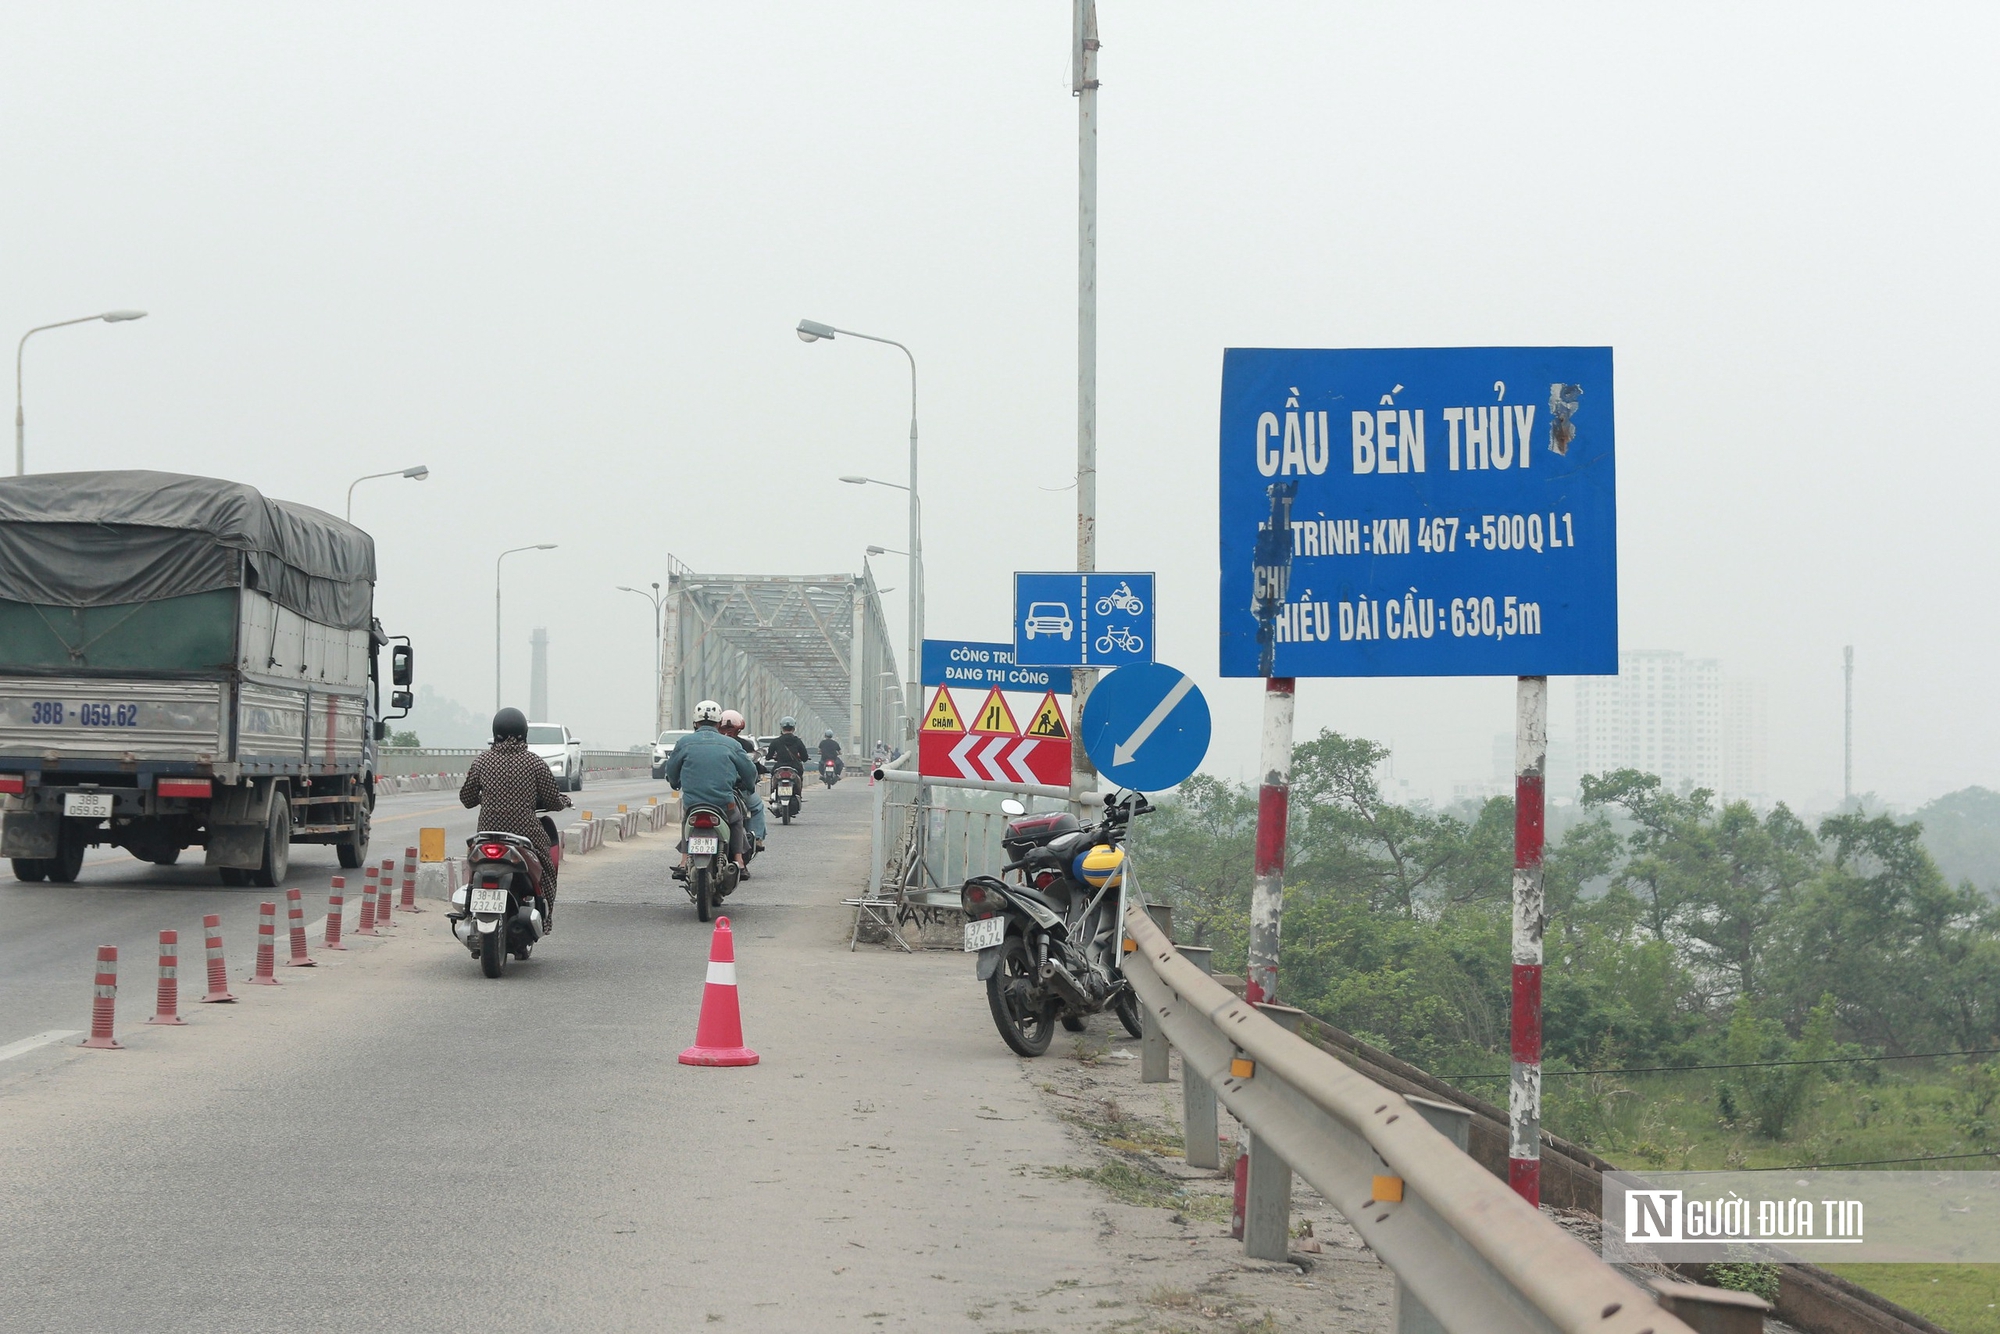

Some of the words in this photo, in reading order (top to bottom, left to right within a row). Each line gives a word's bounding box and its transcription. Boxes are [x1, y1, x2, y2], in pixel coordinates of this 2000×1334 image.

[1256, 386, 1329, 477] CẦU
[1351, 383, 1426, 475] BẾN
[1443, 380, 1536, 471] THỦY
[1417, 517, 1459, 553] 467
[1275, 588, 1331, 643] HIỀU
[1338, 593, 1380, 641] DÀI
[950, 646, 990, 663] CÔNG
[993, 651, 1014, 664] TRU
[945, 666, 983, 681] ĐANG
[986, 669, 1005, 682] THI
[1009, 668, 1049, 685] CÔNG
[32, 701, 63, 725] 38B
[80, 703, 137, 727] 059.62
[939, 702, 947, 712] ĐI
[932, 716, 954, 730] CHẬM
[78, 795, 99, 805] 38B
[70, 805, 106, 816] 059.62
[970, 919, 998, 937] 37-B1
